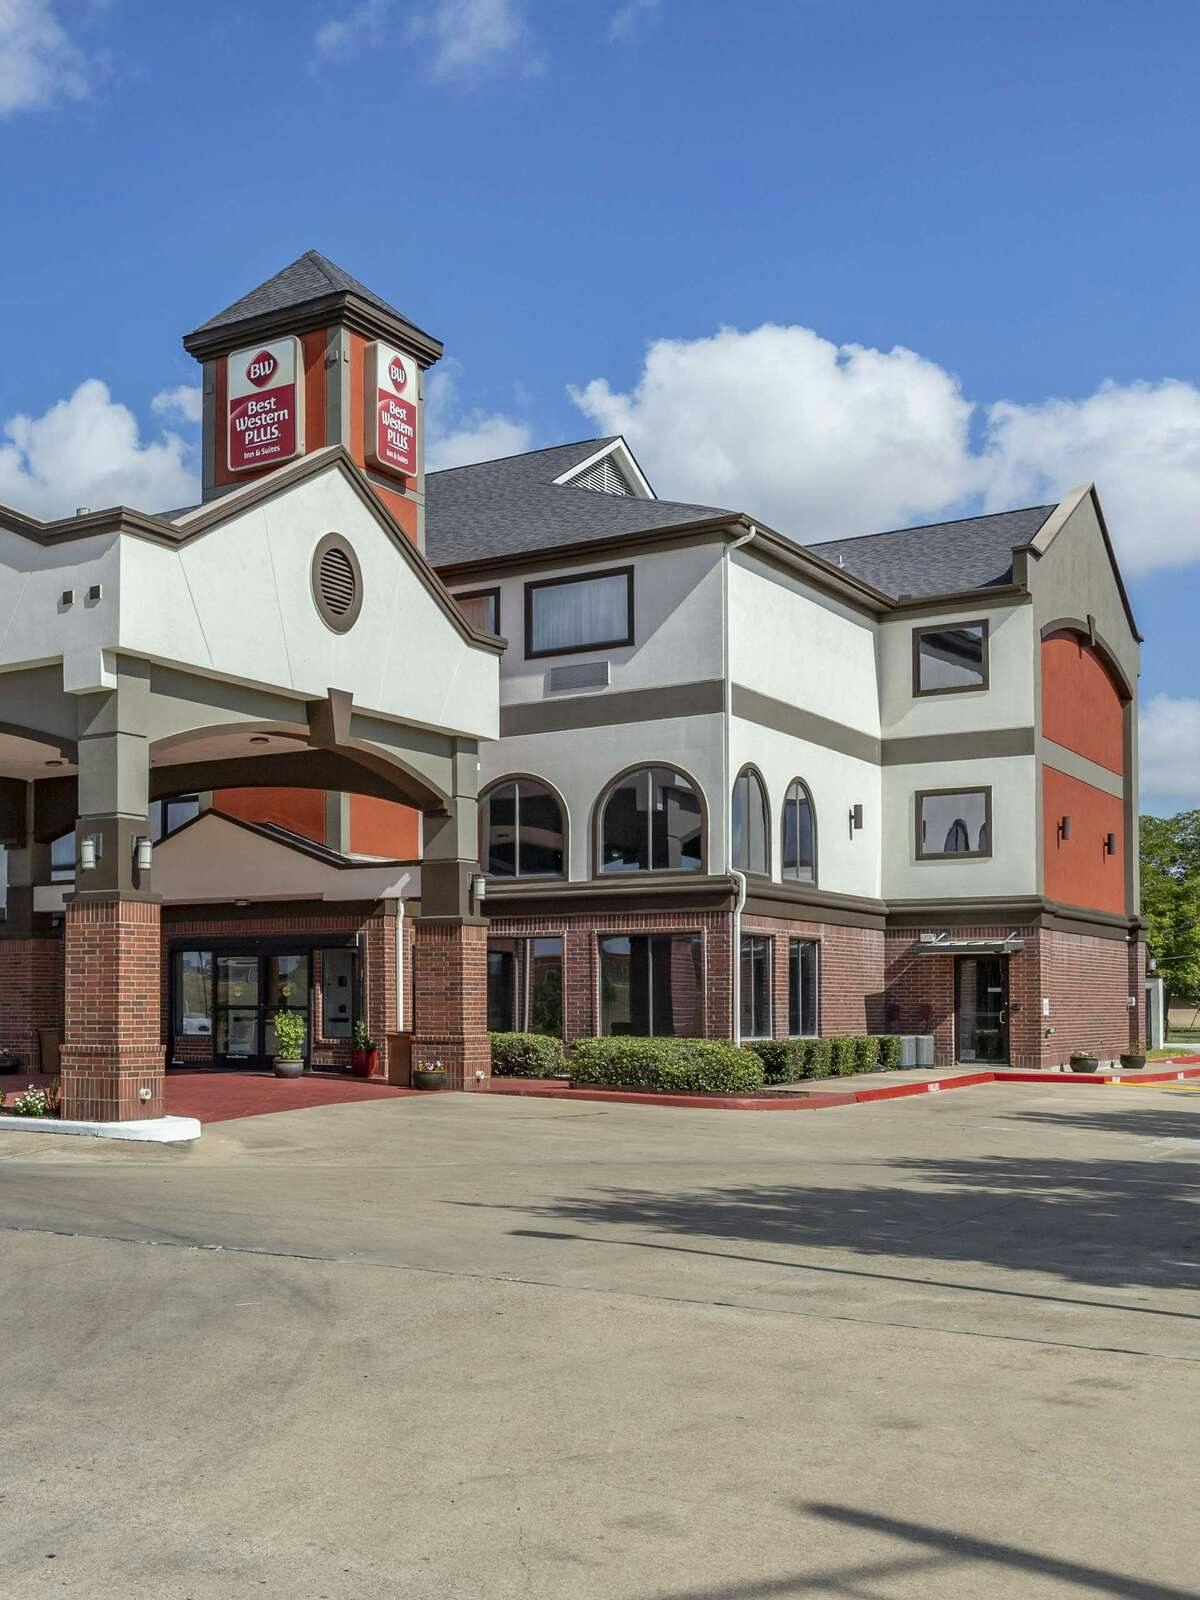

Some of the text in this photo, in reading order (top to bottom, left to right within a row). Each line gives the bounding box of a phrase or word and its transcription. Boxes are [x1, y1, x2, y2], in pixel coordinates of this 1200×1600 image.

[250, 359, 274, 379] BW
[390, 364, 405, 384] BW
[247, 397, 277, 415] Best
[389, 399, 407, 421] Best
[235, 408, 289, 432] Western
[381, 410, 414, 438] Western
[243, 445, 281, 460] Inn & Suites
